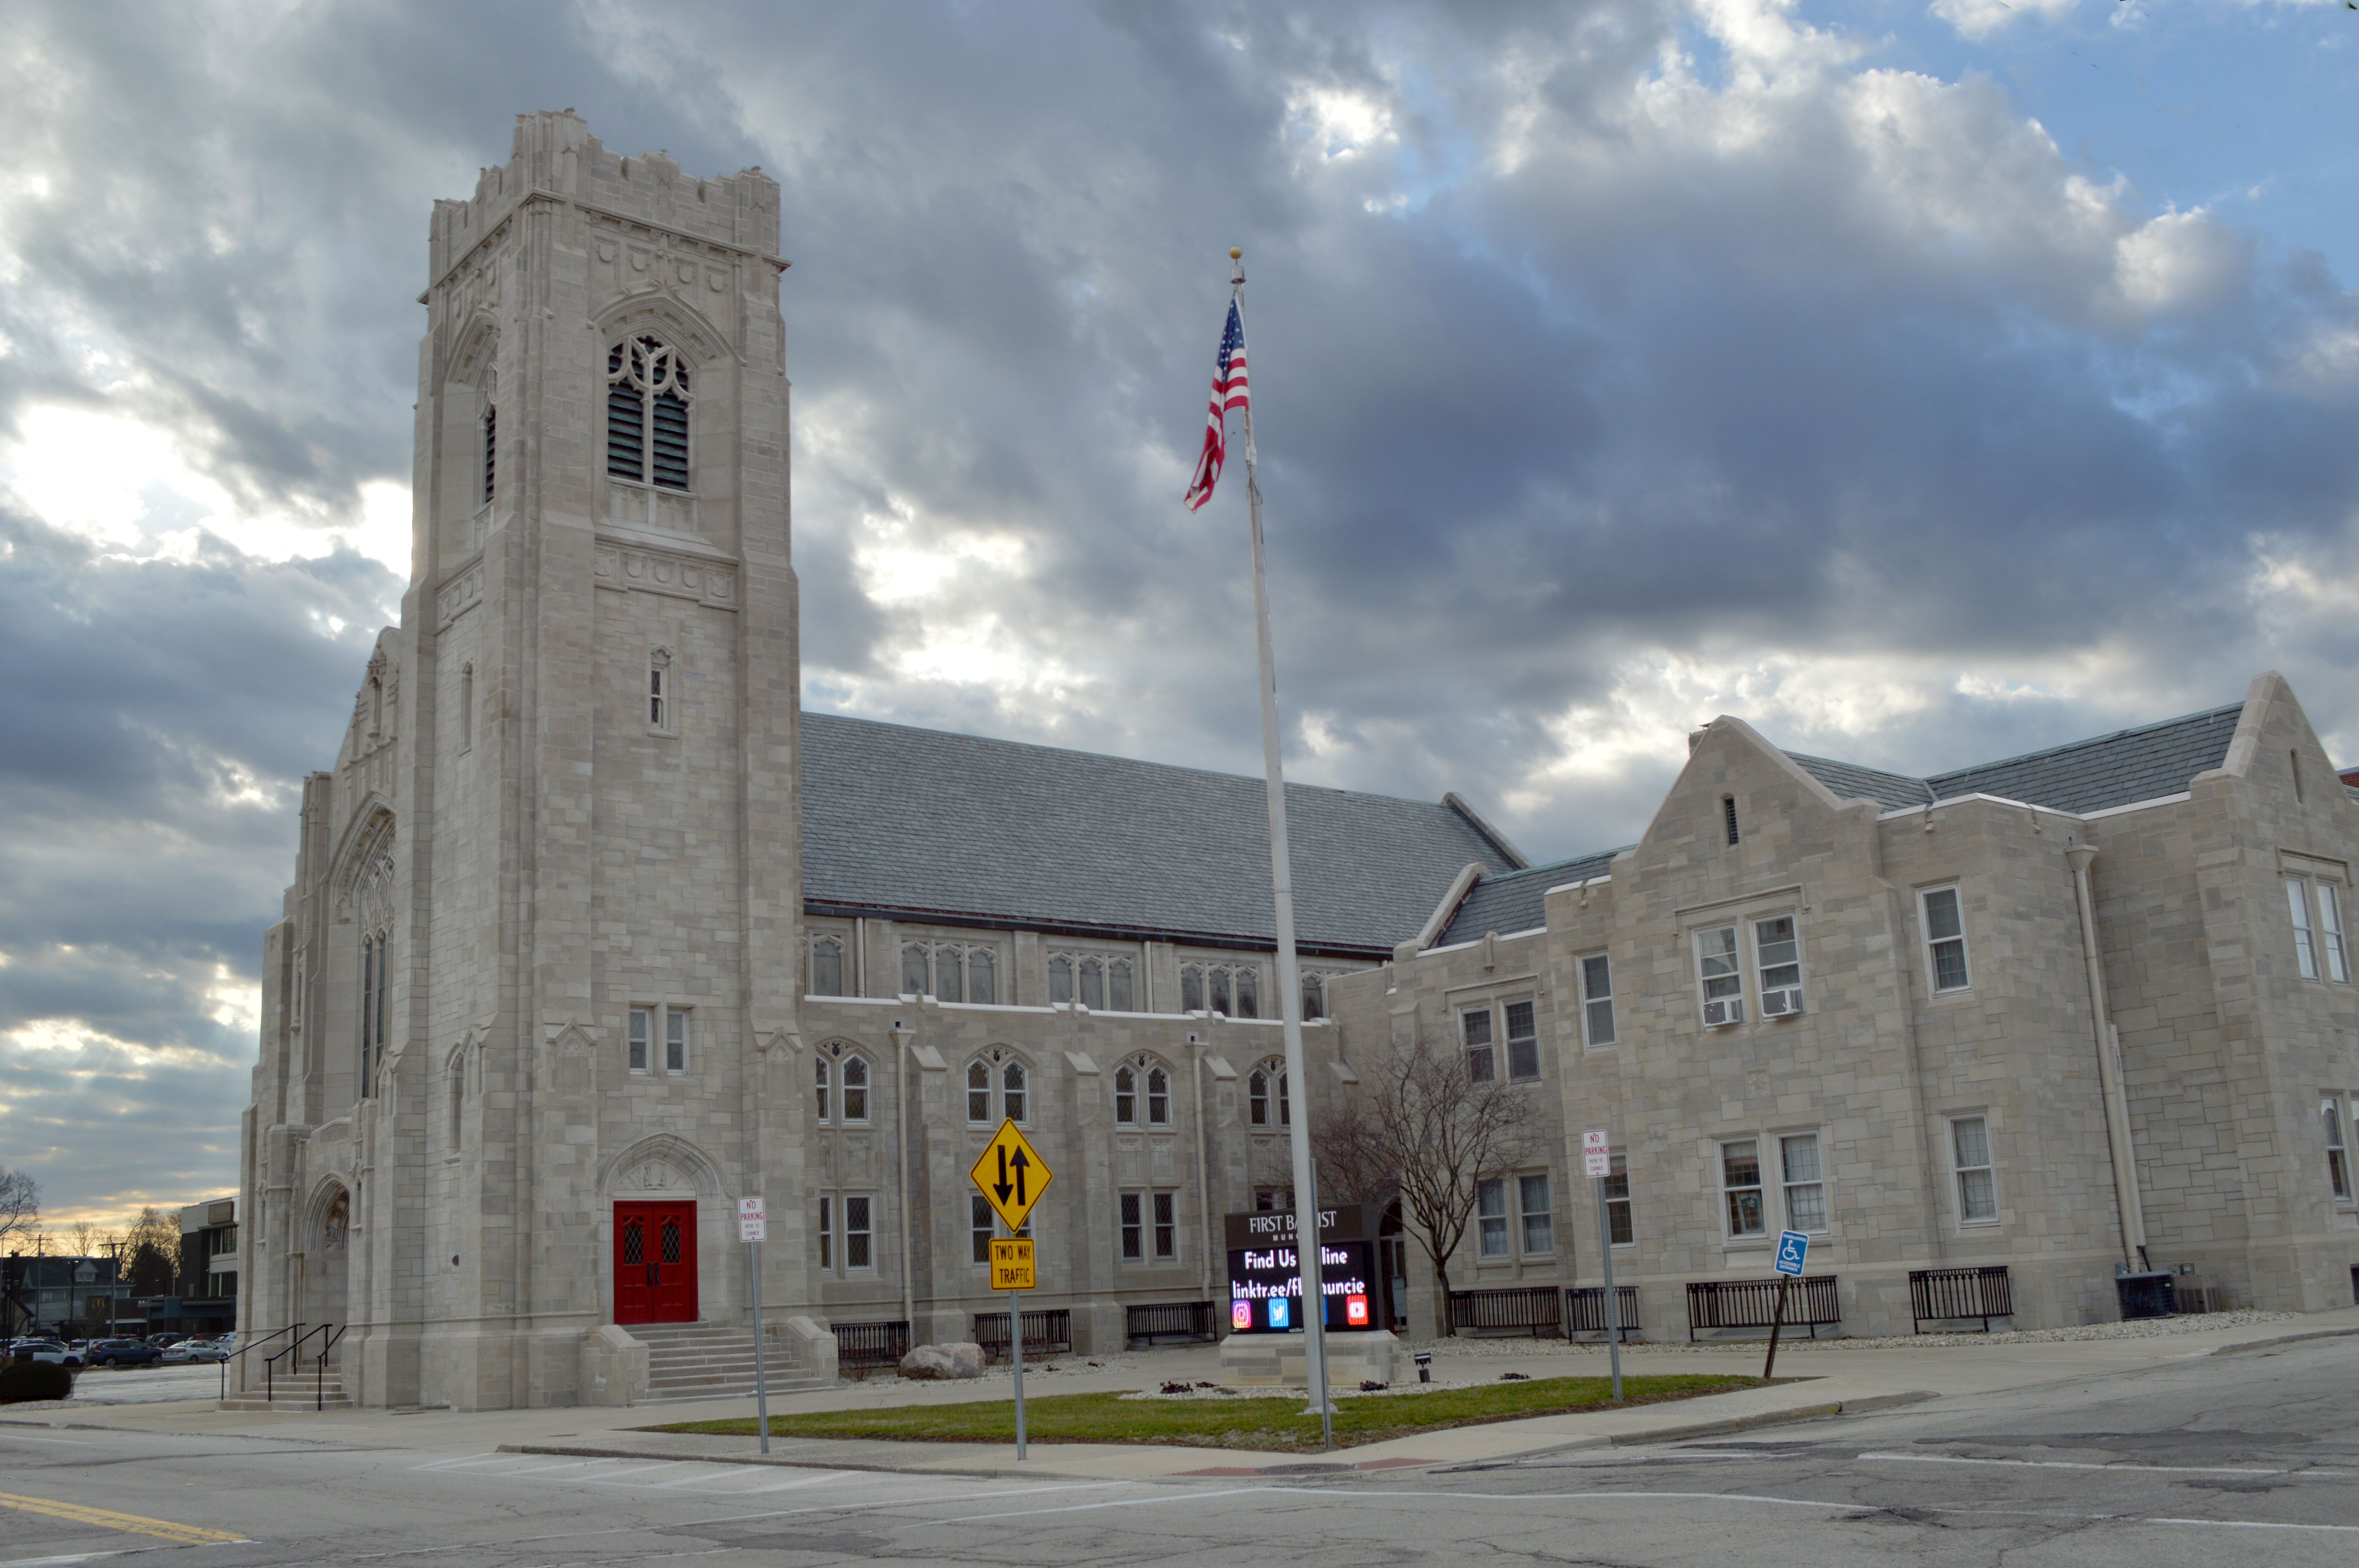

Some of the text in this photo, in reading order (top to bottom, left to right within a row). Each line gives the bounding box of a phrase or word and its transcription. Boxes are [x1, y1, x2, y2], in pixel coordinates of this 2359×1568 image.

[1590, 1134, 1599, 1143] NO
[1585, 1146, 1606, 1155] PARKING
[741, 1212, 763, 1221] PARKING
[1249, 1210, 1337, 1233] FIRST BIST
[995, 1245, 1031, 1260] TWO WAY
[1245, 1246, 1348, 1270] Find Us line
[999, 1268, 1030, 1284] TRAFFIC
